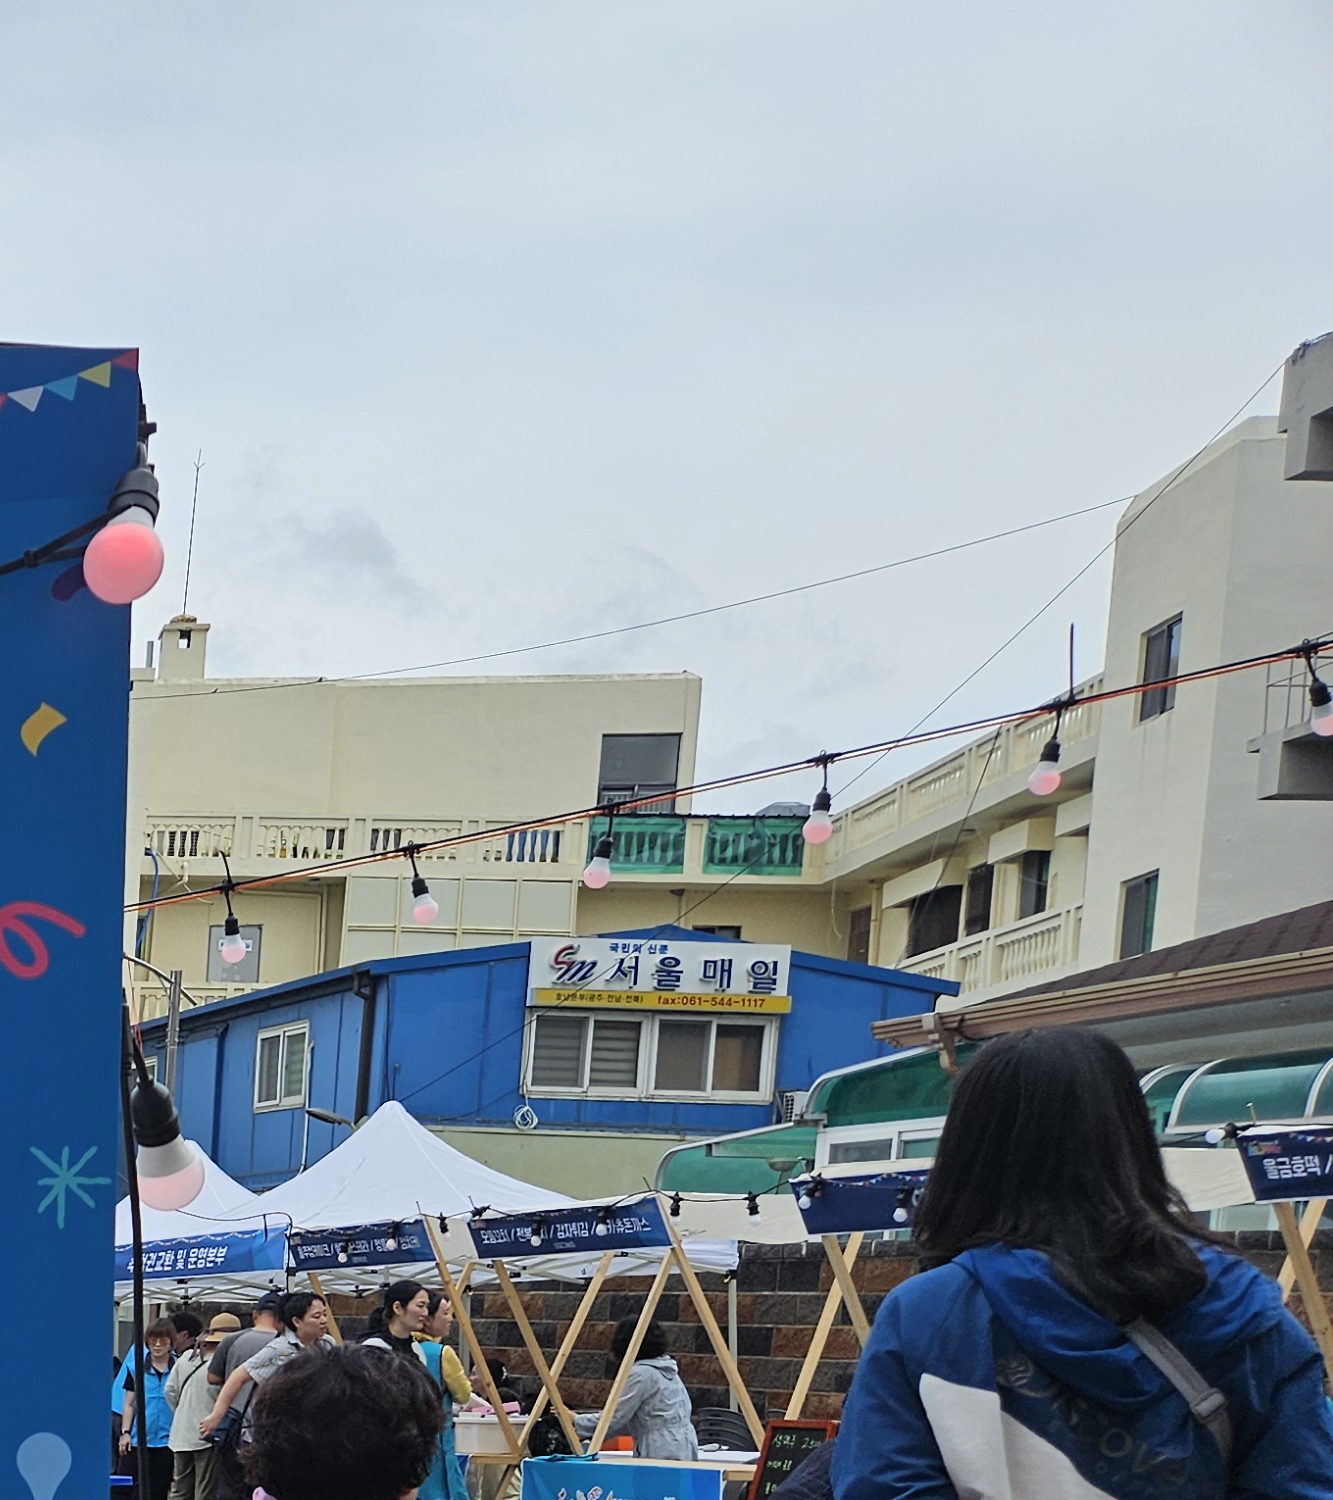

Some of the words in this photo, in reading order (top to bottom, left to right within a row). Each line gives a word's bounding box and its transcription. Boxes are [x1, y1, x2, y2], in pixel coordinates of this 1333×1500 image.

[609, 942, 642, 954] 국민의
[658, 994, 766, 1009] fax:061-544-1117
[1262, 1155, 1322, 1180] 울금호떡
[516, 1226, 548, 1242] 전복치
[598, 1217, 652, 1235] 카츄돈까스
[176, 1249, 187, 1270] 및
[188, 1245, 228, 1269] 운영본부
